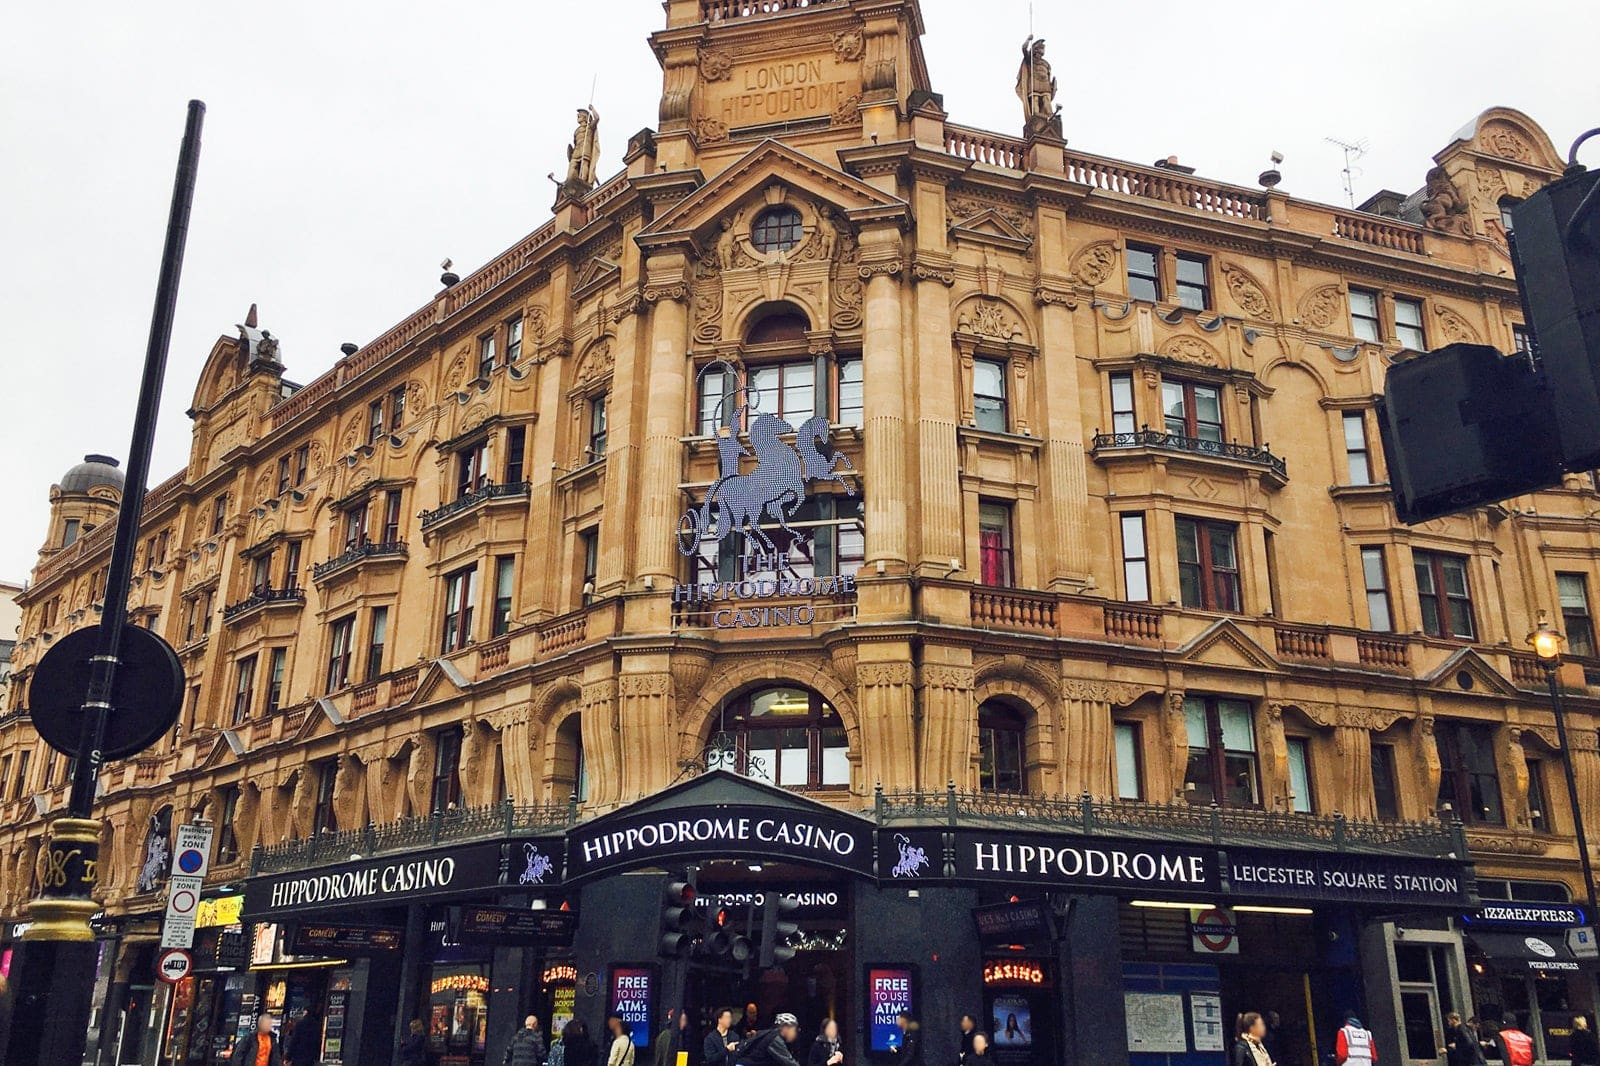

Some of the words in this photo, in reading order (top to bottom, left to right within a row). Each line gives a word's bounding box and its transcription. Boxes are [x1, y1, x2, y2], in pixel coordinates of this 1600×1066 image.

[744, 59, 822, 91] LONDON
[722, 81, 847, 119] HIPPODROME
[739, 552, 790, 573] THE
[674, 575, 857, 601] HIPPODROME
[713, 605, 815, 629] CASINO
[180, 826, 211, 834] Restricted
[583, 818, 750, 862] HIPPODROME
[756, 819, 855, 855] CASINO
[975, 843, 1205, 883] HIPPODROME
[270, 868, 378, 907] HIPPODROME
[381, 857, 455, 893] CASINO
[1233, 865, 1316, 885] LEICESTER
[1323, 871, 1387, 890] SQUARE
[1394, 875, 1458, 893] STATION
[476, 913, 507, 923] COMEDY
[1476, 907, 1575, 922] IZZAEXPRESS
[309, 928, 338, 938] COMEDY
[617, 976, 648, 989] FREE
[984, 965, 1043, 983] CASINO
[875, 979, 908, 991] FREE
[617, 990, 629, 999] TO
[631, 990, 647, 999] USE
[874, 992, 888, 1001] TO
[890, 992, 908, 1001] USE
[616, 1000, 647, 1012] ATM's
